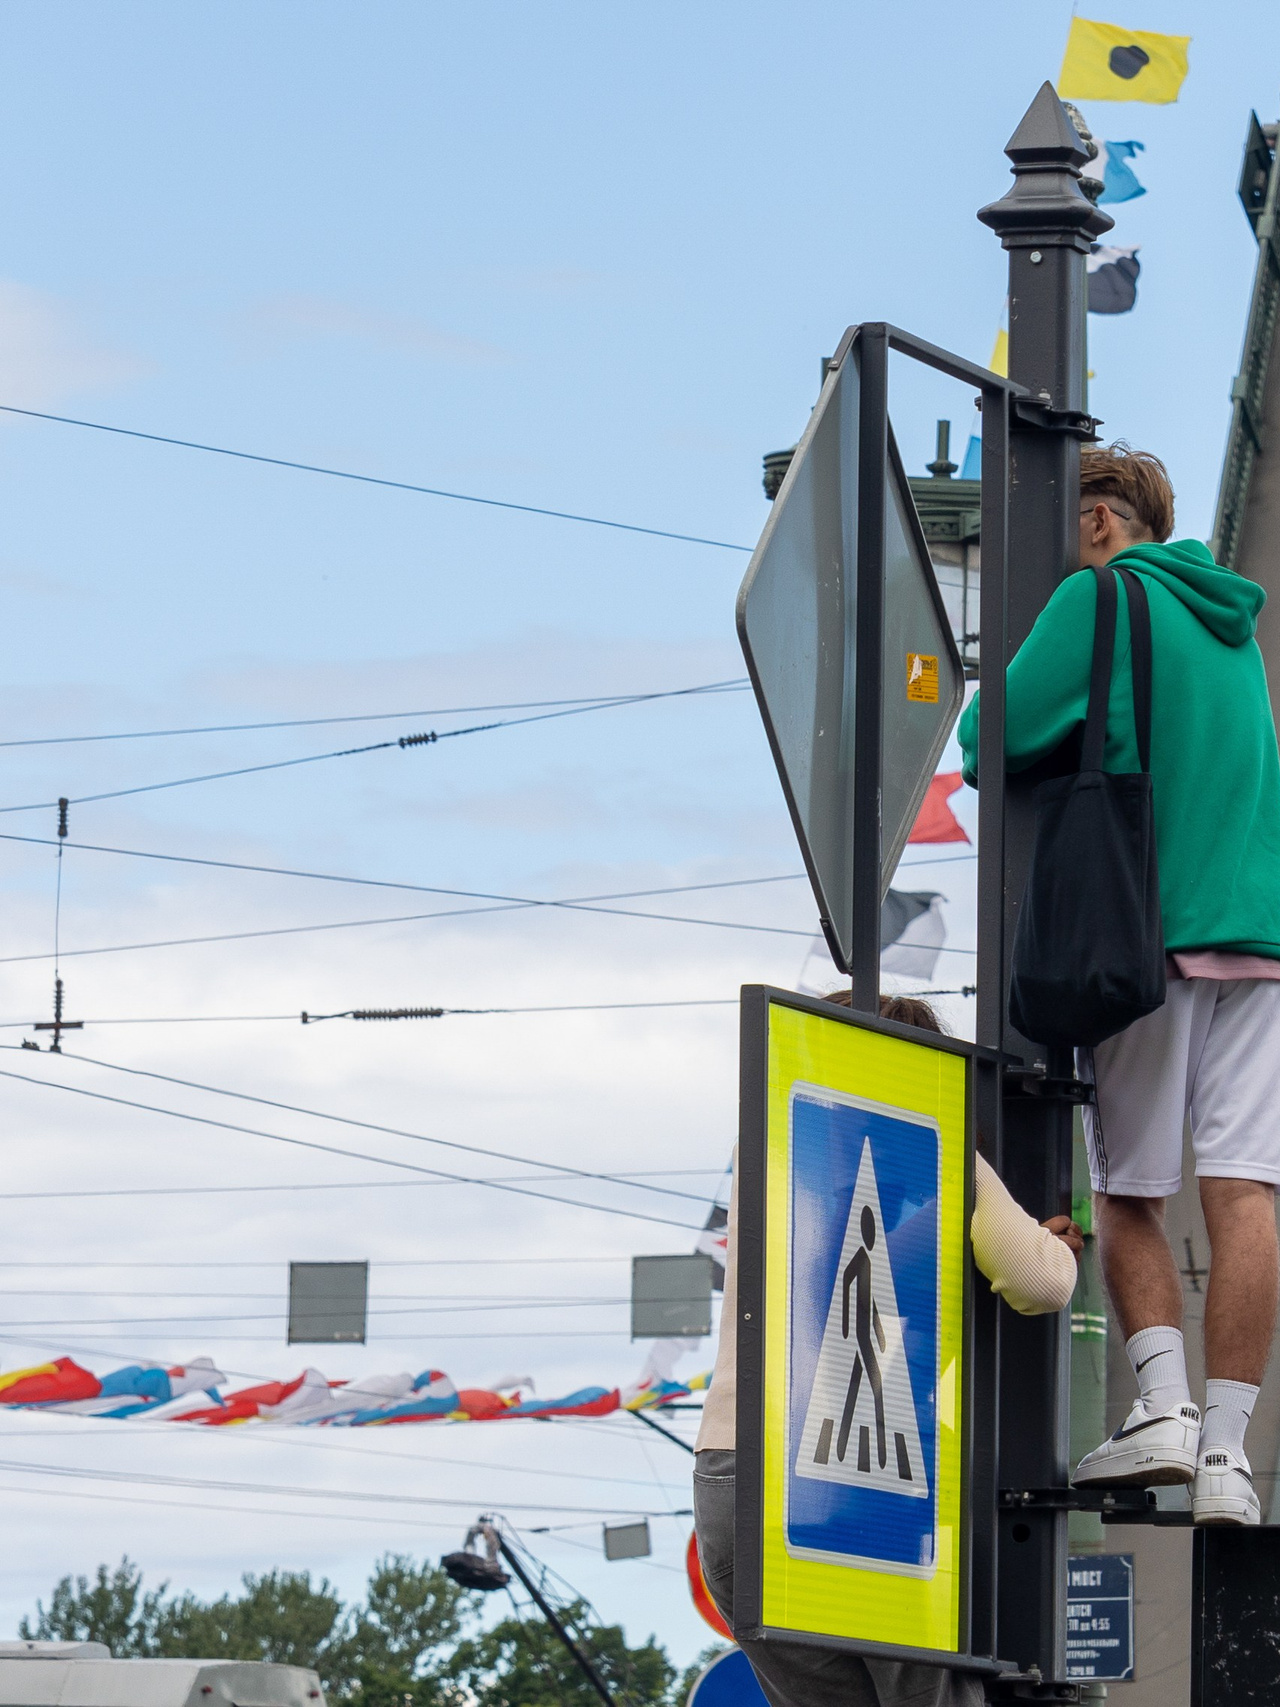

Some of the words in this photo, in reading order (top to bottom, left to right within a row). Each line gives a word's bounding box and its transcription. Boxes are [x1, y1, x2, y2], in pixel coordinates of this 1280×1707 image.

[1180, 1407, 1200, 1423] NIKE
[1205, 1454, 1228, 1467] NIKE
[1071, 1570, 1103, 1587] МОСТ
